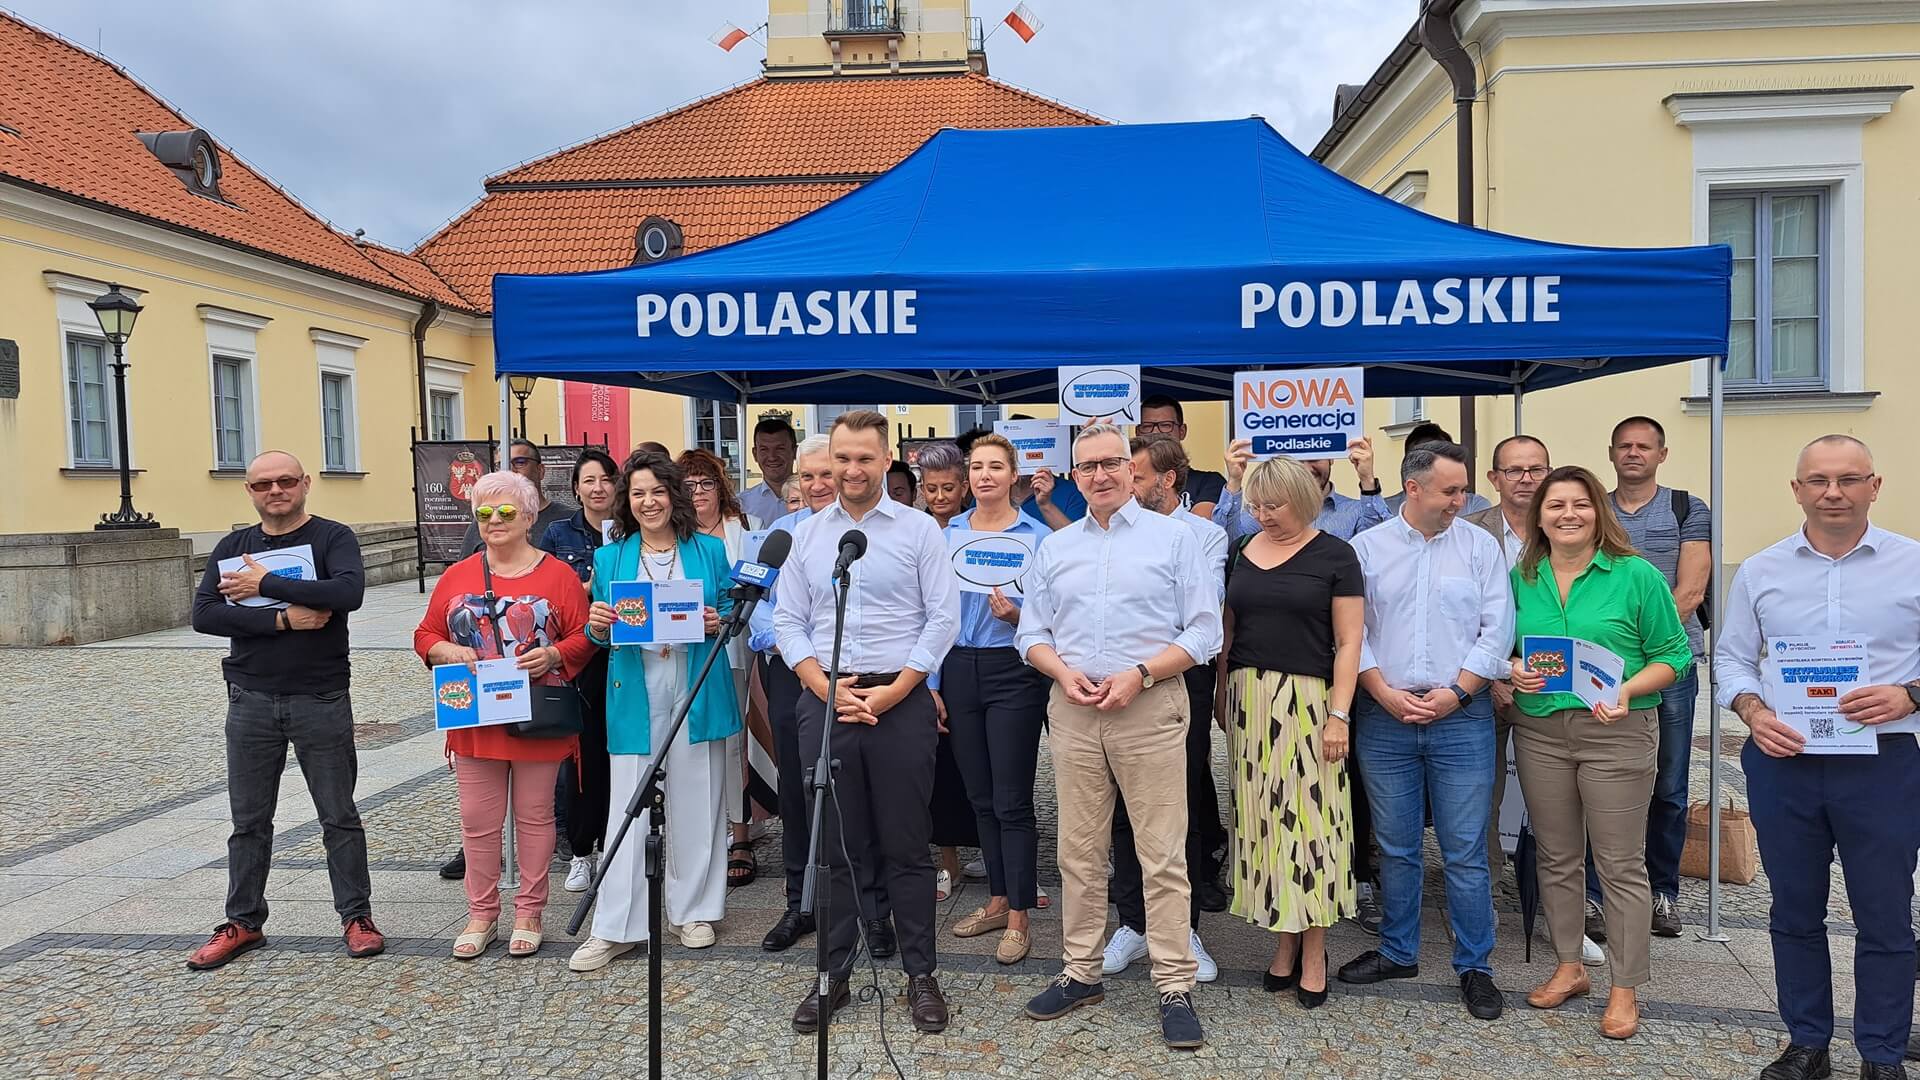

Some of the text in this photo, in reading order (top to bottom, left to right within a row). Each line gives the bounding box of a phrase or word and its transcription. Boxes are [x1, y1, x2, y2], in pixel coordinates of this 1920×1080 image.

[1241, 275, 1561, 329] PODLASKIE
[636, 289, 918, 337] PODLASKIE
[1242, 378, 1355, 410] NOWA
[1243, 409, 1355, 430] Generacja
[1266, 437, 1332, 451] Podlaskie
[425, 483, 446, 493] 160.
[424, 503, 458, 511] Powstania
[1809, 688, 1834, 696] TAK!
